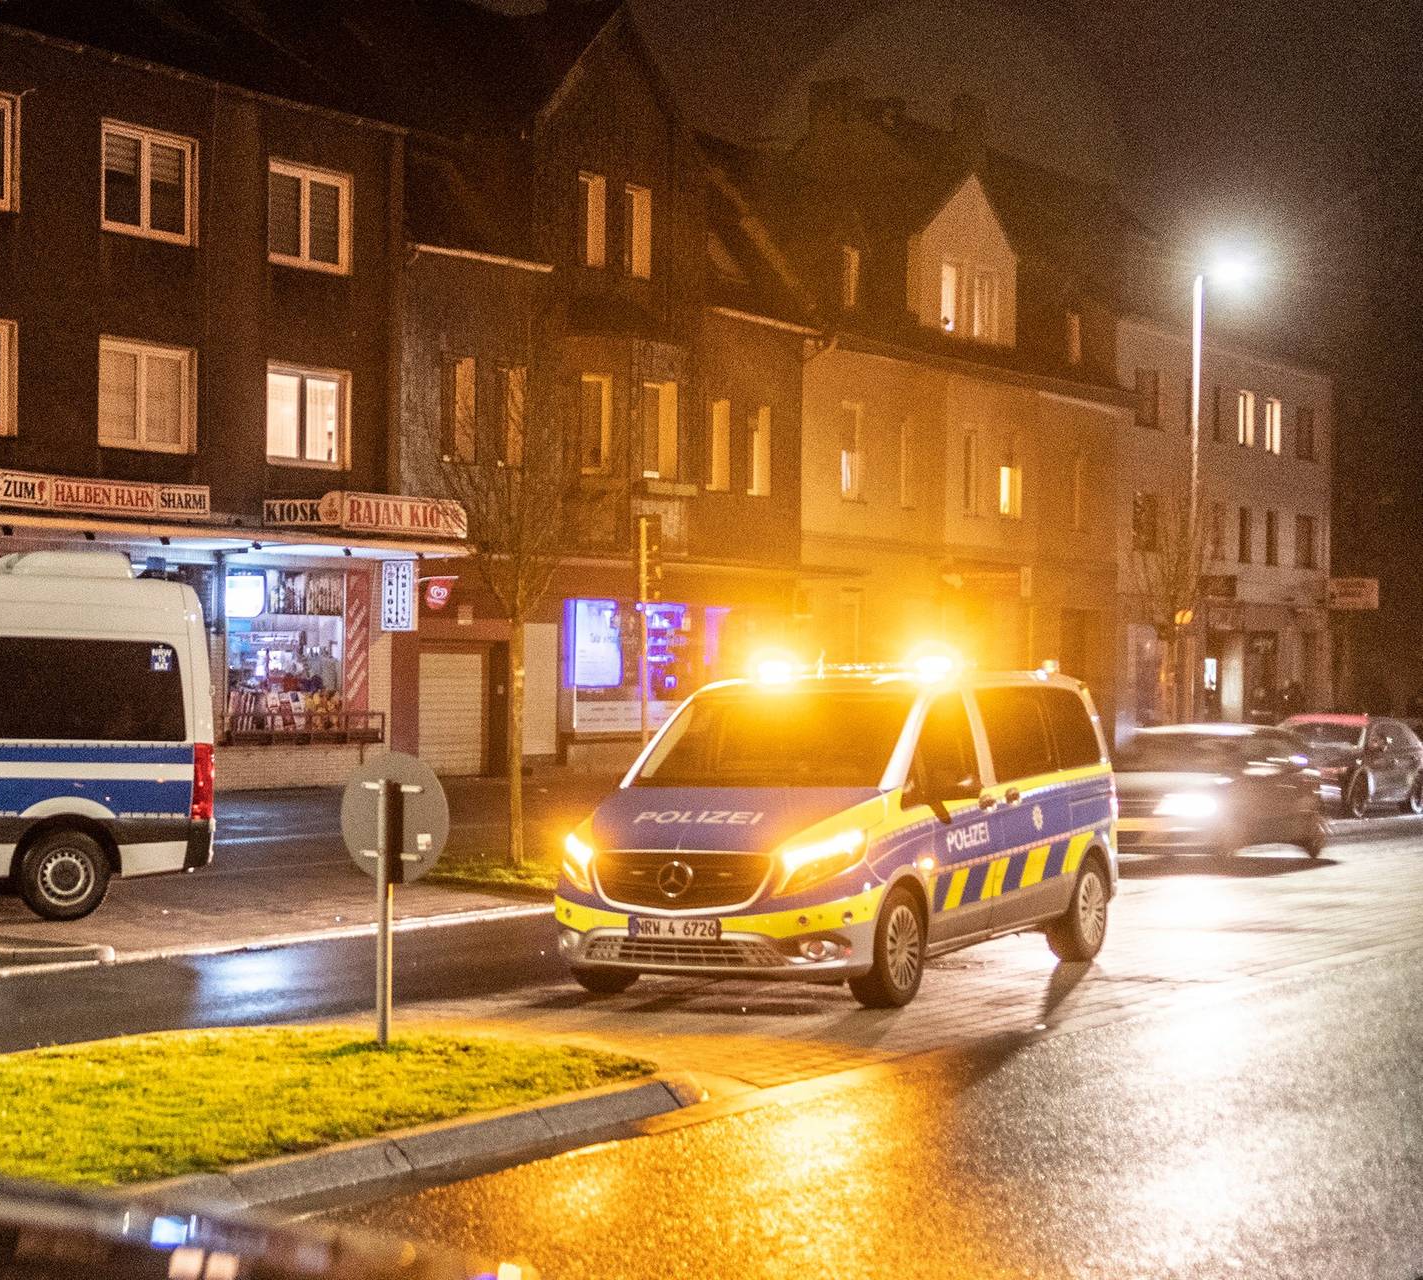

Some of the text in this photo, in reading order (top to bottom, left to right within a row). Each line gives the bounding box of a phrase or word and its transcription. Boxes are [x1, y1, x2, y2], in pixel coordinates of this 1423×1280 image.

[3, 479, 207, 510] ZUM HALBEN HAHN SHARMI
[265, 501, 322, 524] KIOSK
[349, 499, 465, 534] RAJAN KIO
[386, 579, 394, 624] KIOSK
[634, 810, 765, 825] POLIZEI
[946, 820, 990, 853] POLIZEI
[638, 919, 716, 937] NRW 4 6726
